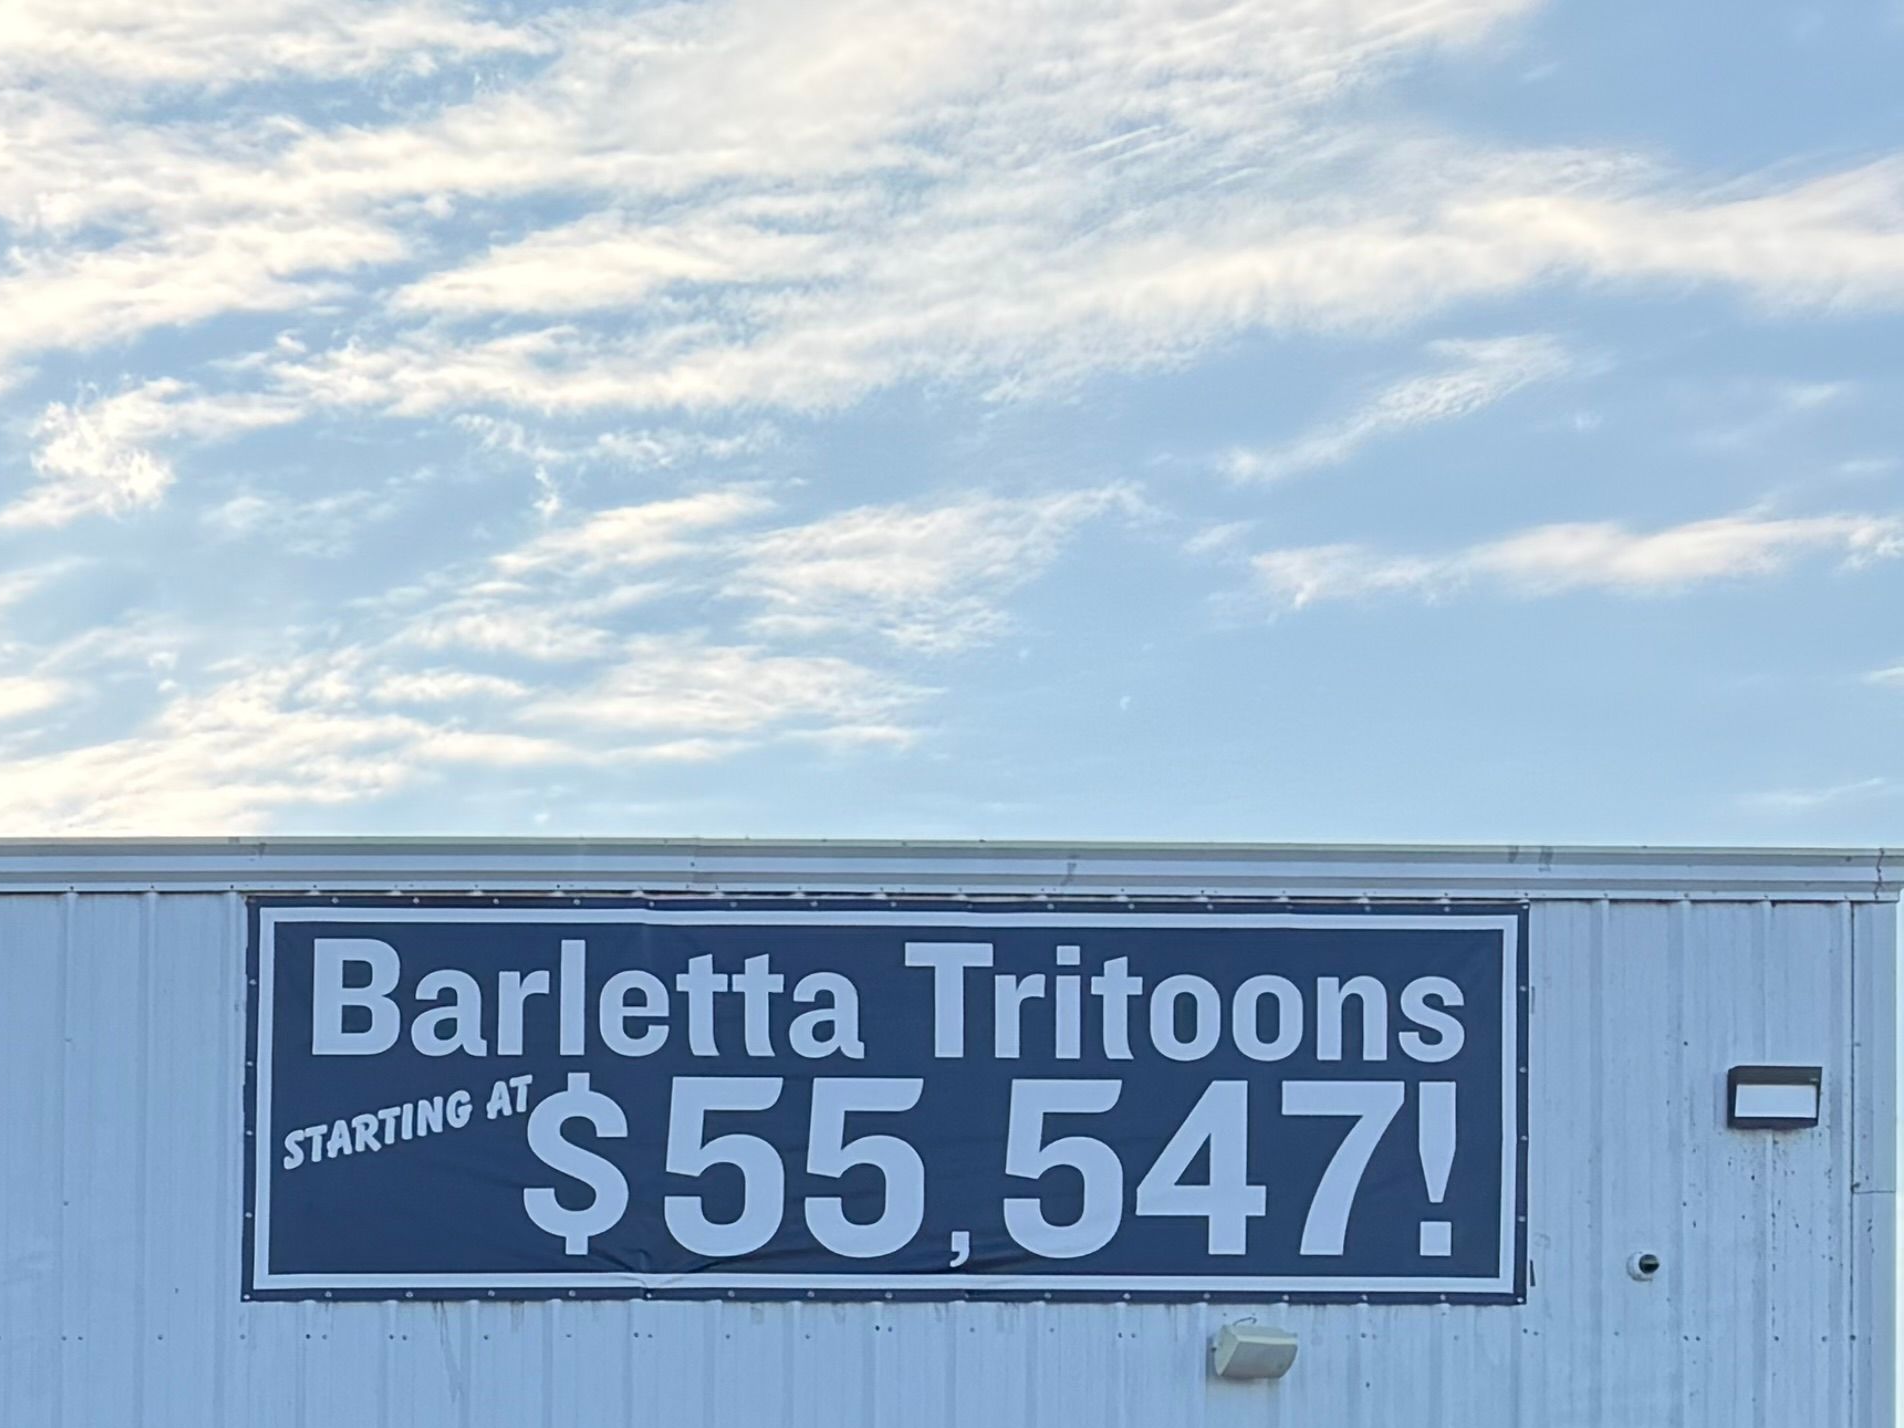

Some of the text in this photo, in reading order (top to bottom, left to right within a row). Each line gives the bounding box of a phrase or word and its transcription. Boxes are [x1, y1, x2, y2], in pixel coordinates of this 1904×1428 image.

[311, 937, 1466, 1064] Barletta Tritoons
[282, 1073, 533, 1170] STARTING AT
[522, 1071, 1458, 1269] $55,547!
